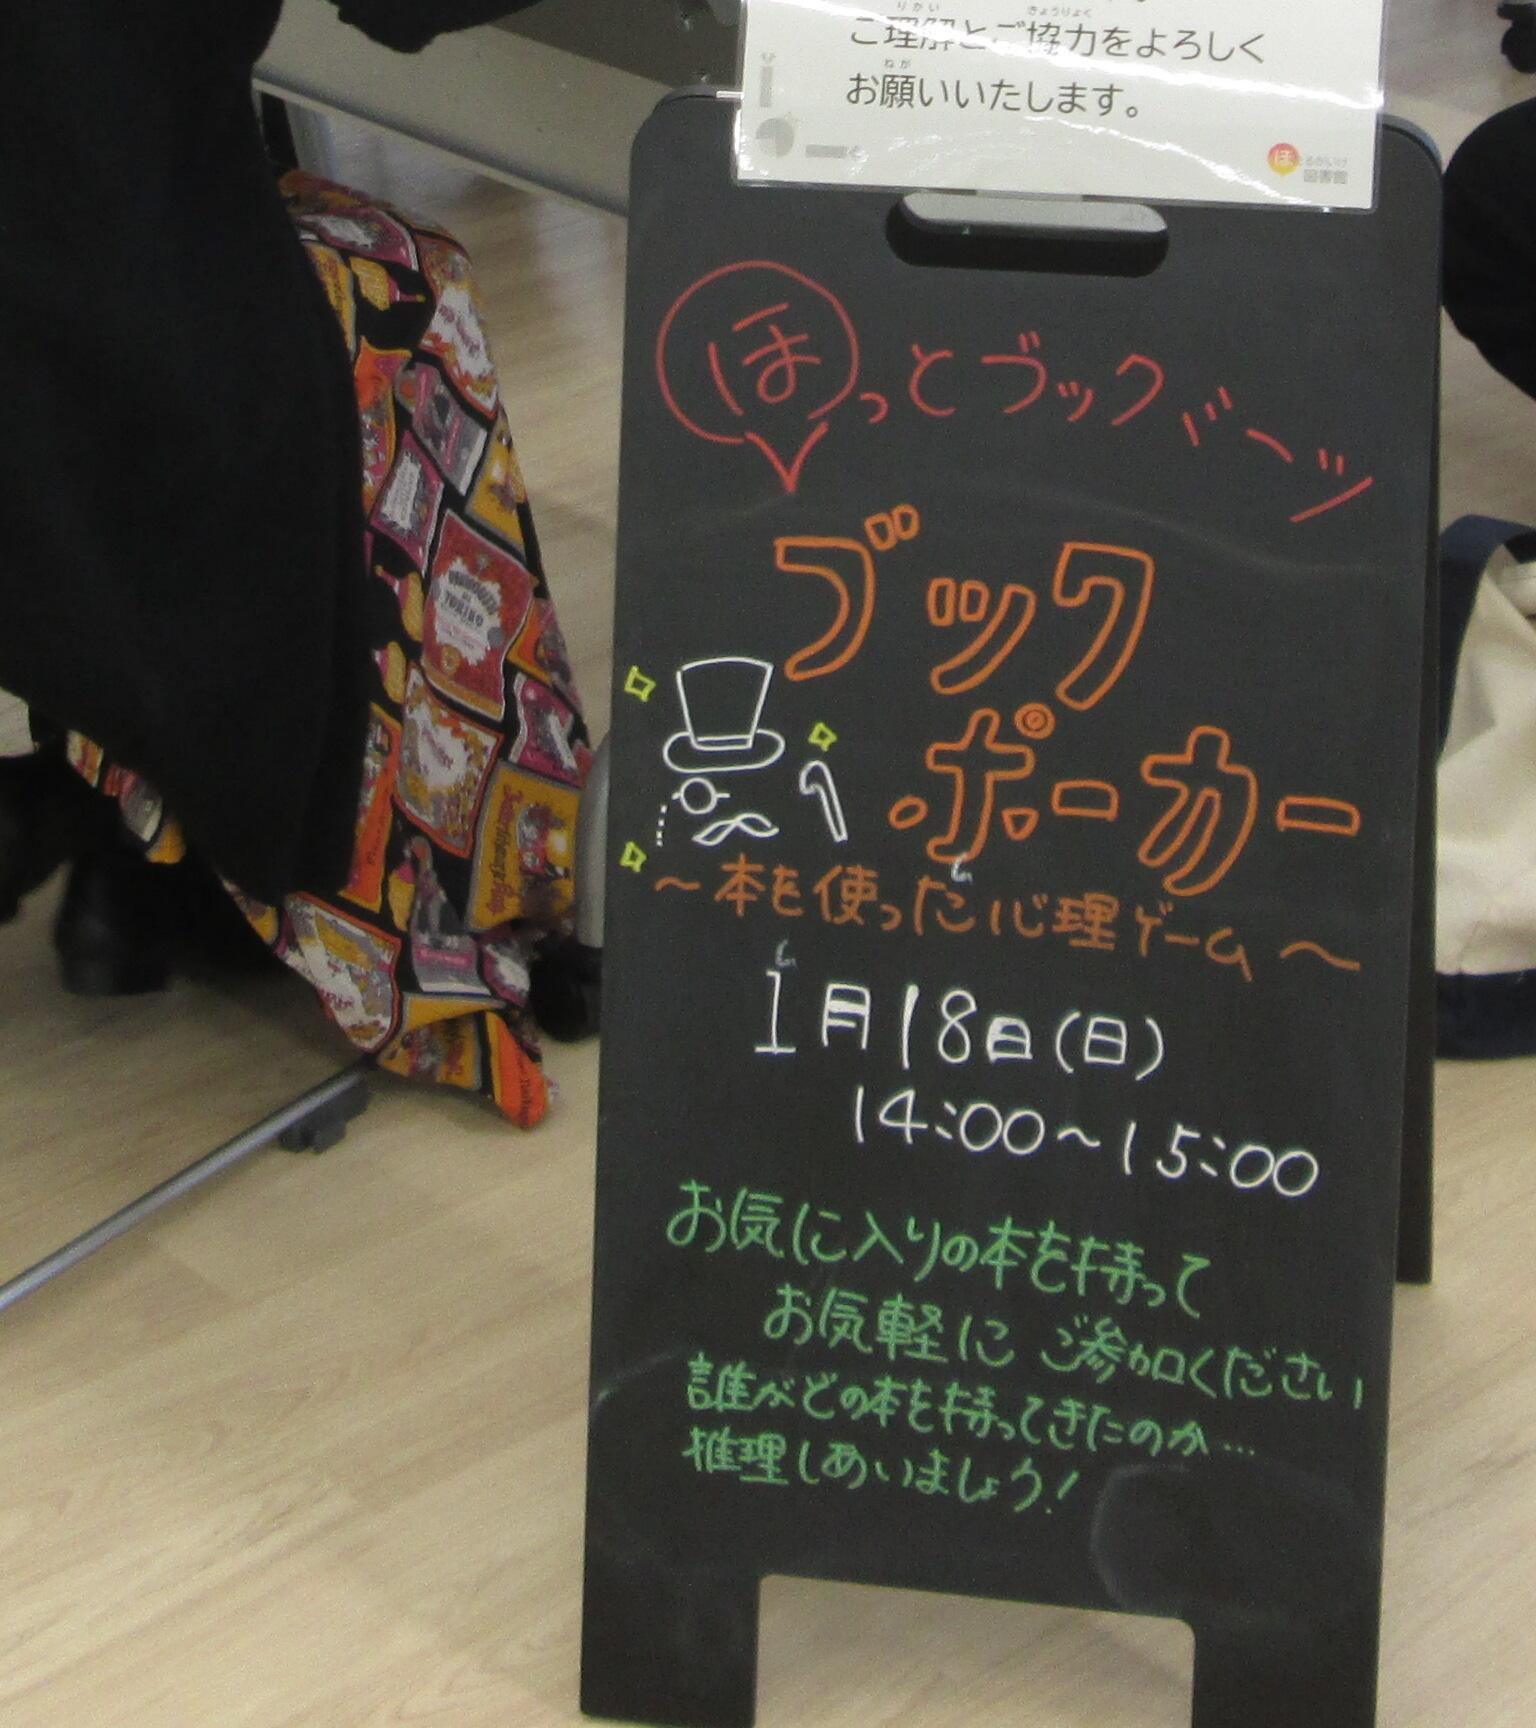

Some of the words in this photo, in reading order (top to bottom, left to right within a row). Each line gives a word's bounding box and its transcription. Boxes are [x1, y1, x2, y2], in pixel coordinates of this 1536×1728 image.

[846, 72, 1139, 120] お願いいたします。
[773, 504, 1155, 711] ブック
[889, 709, 1360, 897] ポーカー
[665, 1179, 1211, 1319] お気に入りの本を持って
